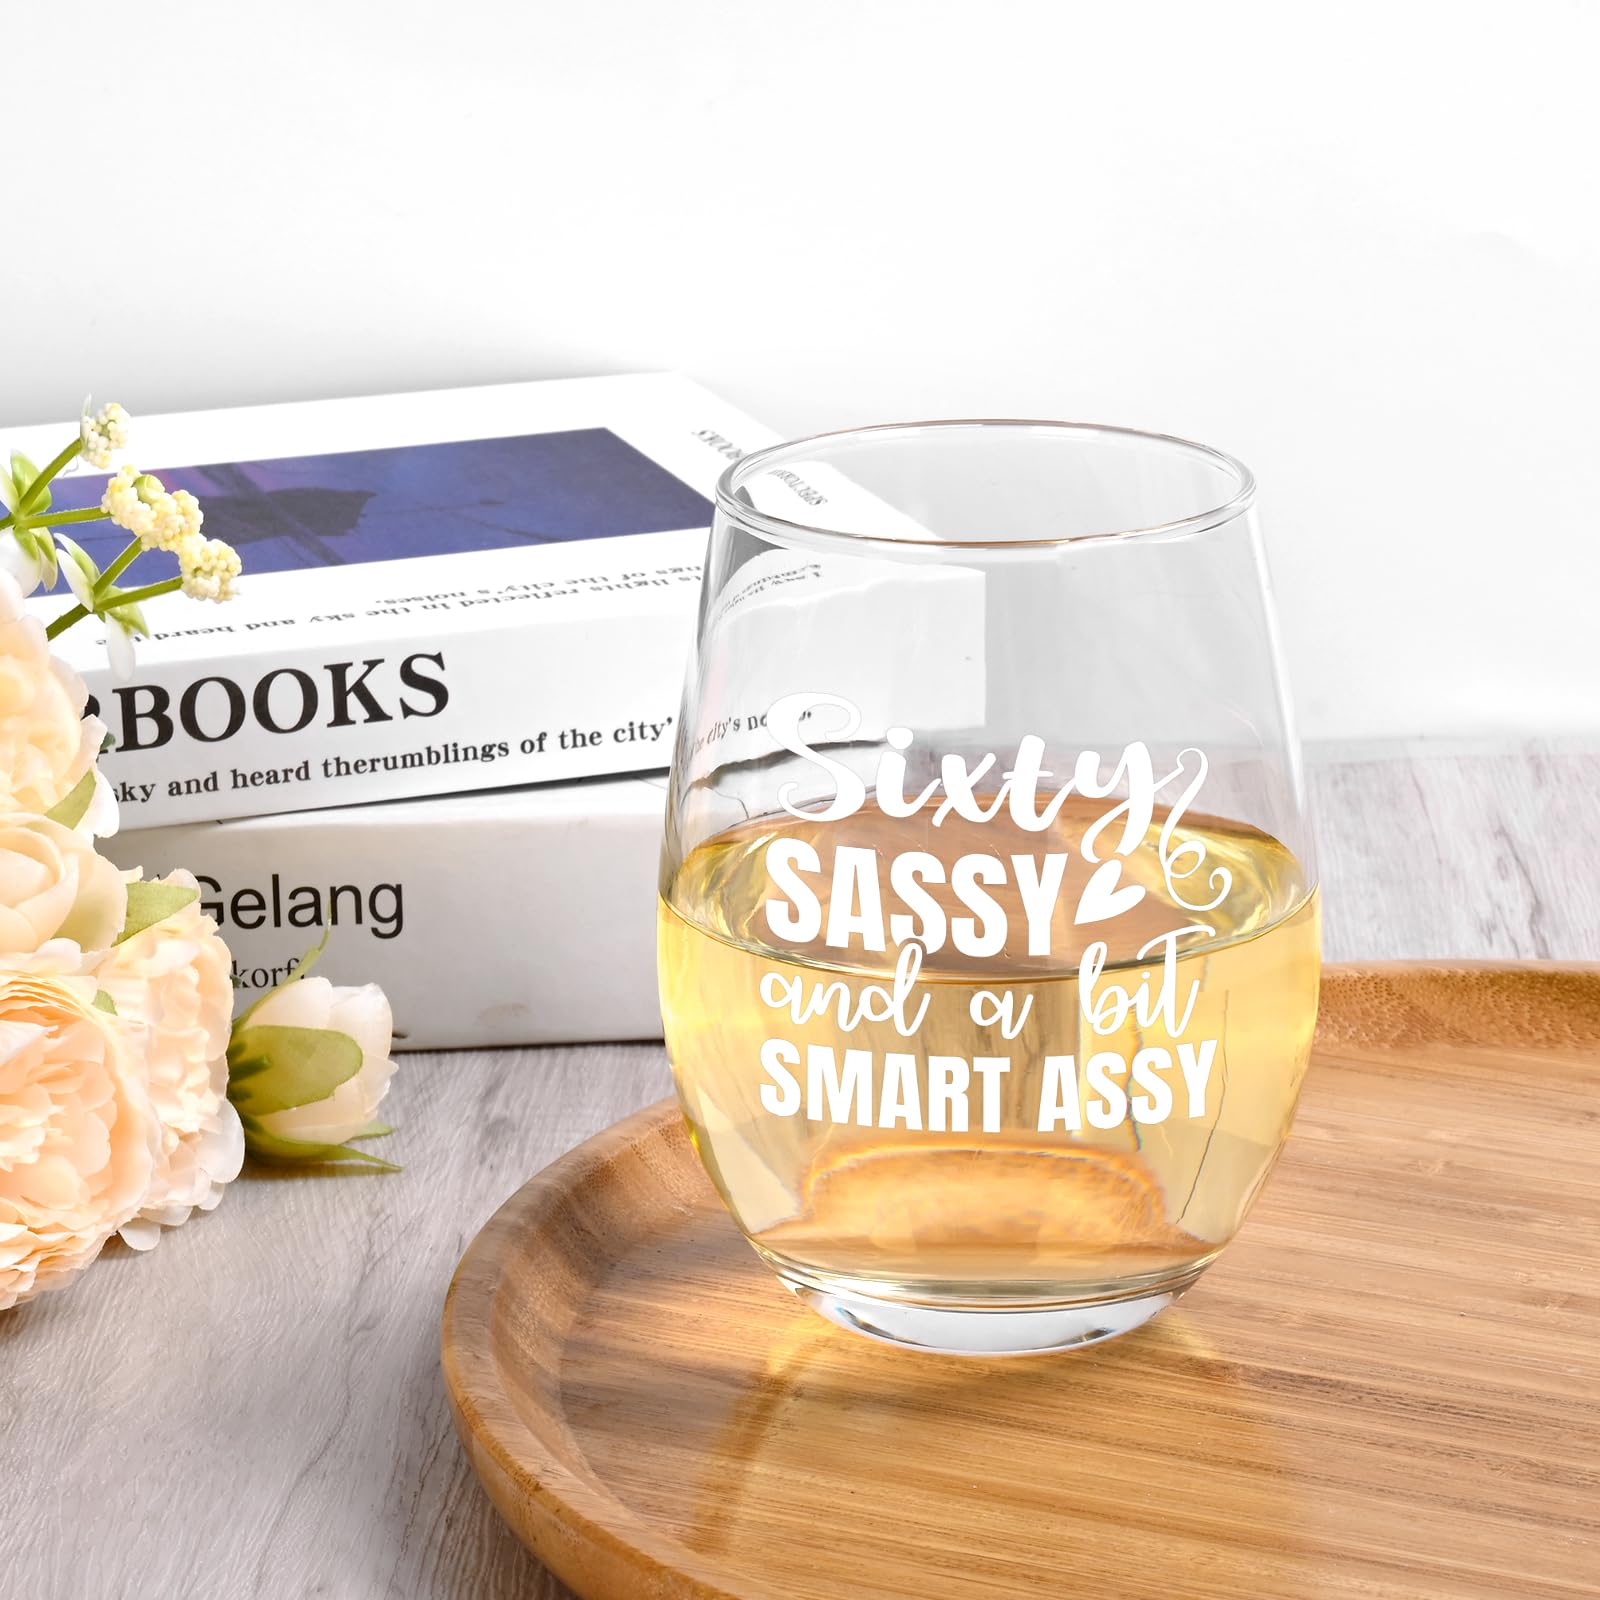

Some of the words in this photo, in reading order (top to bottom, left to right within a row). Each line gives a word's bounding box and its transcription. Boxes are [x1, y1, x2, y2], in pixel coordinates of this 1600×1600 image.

[564, 575, 609, 586] the
[421, 602, 451, 611] in
[460, 588, 580, 609] reflected
[309, 612, 356, 623] sky
[365, 606, 411, 617] the
[153, 624, 236, 642] heard
[244, 617, 297, 632] and
[167, 771, 218, 798] and
[230, 760, 311, 790] heard
[322, 741, 510, 779] therumblings
[520, 731, 548, 755] of
[560, 728, 603, 751] the
[766, 691, 1233, 912] Sixty
[765, 837, 1068, 958] SASSY
[758, 937, 934, 1038] and
[968, 990, 1034, 1040] a
[759, 1038, 1011, 1134] SMART
[1036, 1038, 1218, 1133] ASSY
